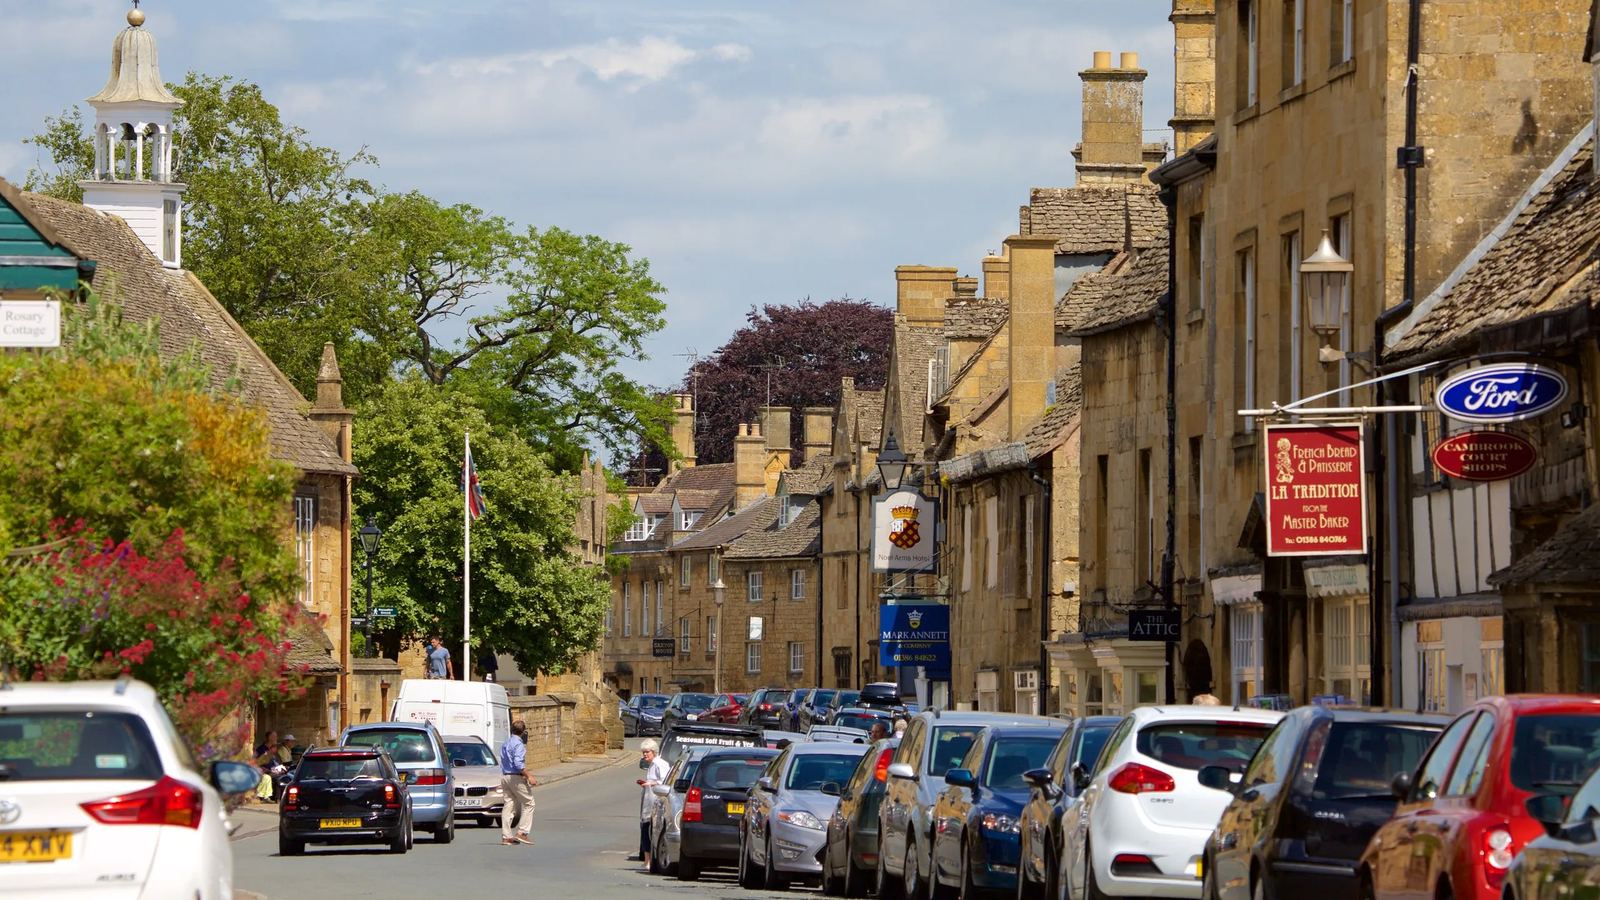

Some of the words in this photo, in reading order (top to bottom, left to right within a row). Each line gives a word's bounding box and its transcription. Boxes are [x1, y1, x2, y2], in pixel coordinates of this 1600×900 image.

[5, 311, 43, 323] Rosary
[3, 325, 46, 337] Cottage
[1464, 377, 1538, 410] Ford
[1293, 445, 1325, 459] FRENCH
[1327, 444, 1357, 458] BREAD
[1443, 443, 1523, 452] CAMBROOK
[1460, 453, 1508, 461] COURT
[1298, 459, 1306, 473] &
[1309, 459, 1352, 473] PATISSERIE
[1462, 464, 1507, 472] SHOPS
[1272, 485, 1288, 499] LA
[1292, 484, 1359, 499] TRADITION
[1282, 515, 1317, 529] MASTER
[1319, 513, 1349, 528] BAKER
[1296, 536, 1318, 544] 01386
[1132, 621, 1179, 635] ATTIC
[882, 631, 909, 639] MARK
[910, 631, 948, 639] ANNETT
[676, 735, 704, 744] Seasonal
[22, 832, 67, 856] XWV
